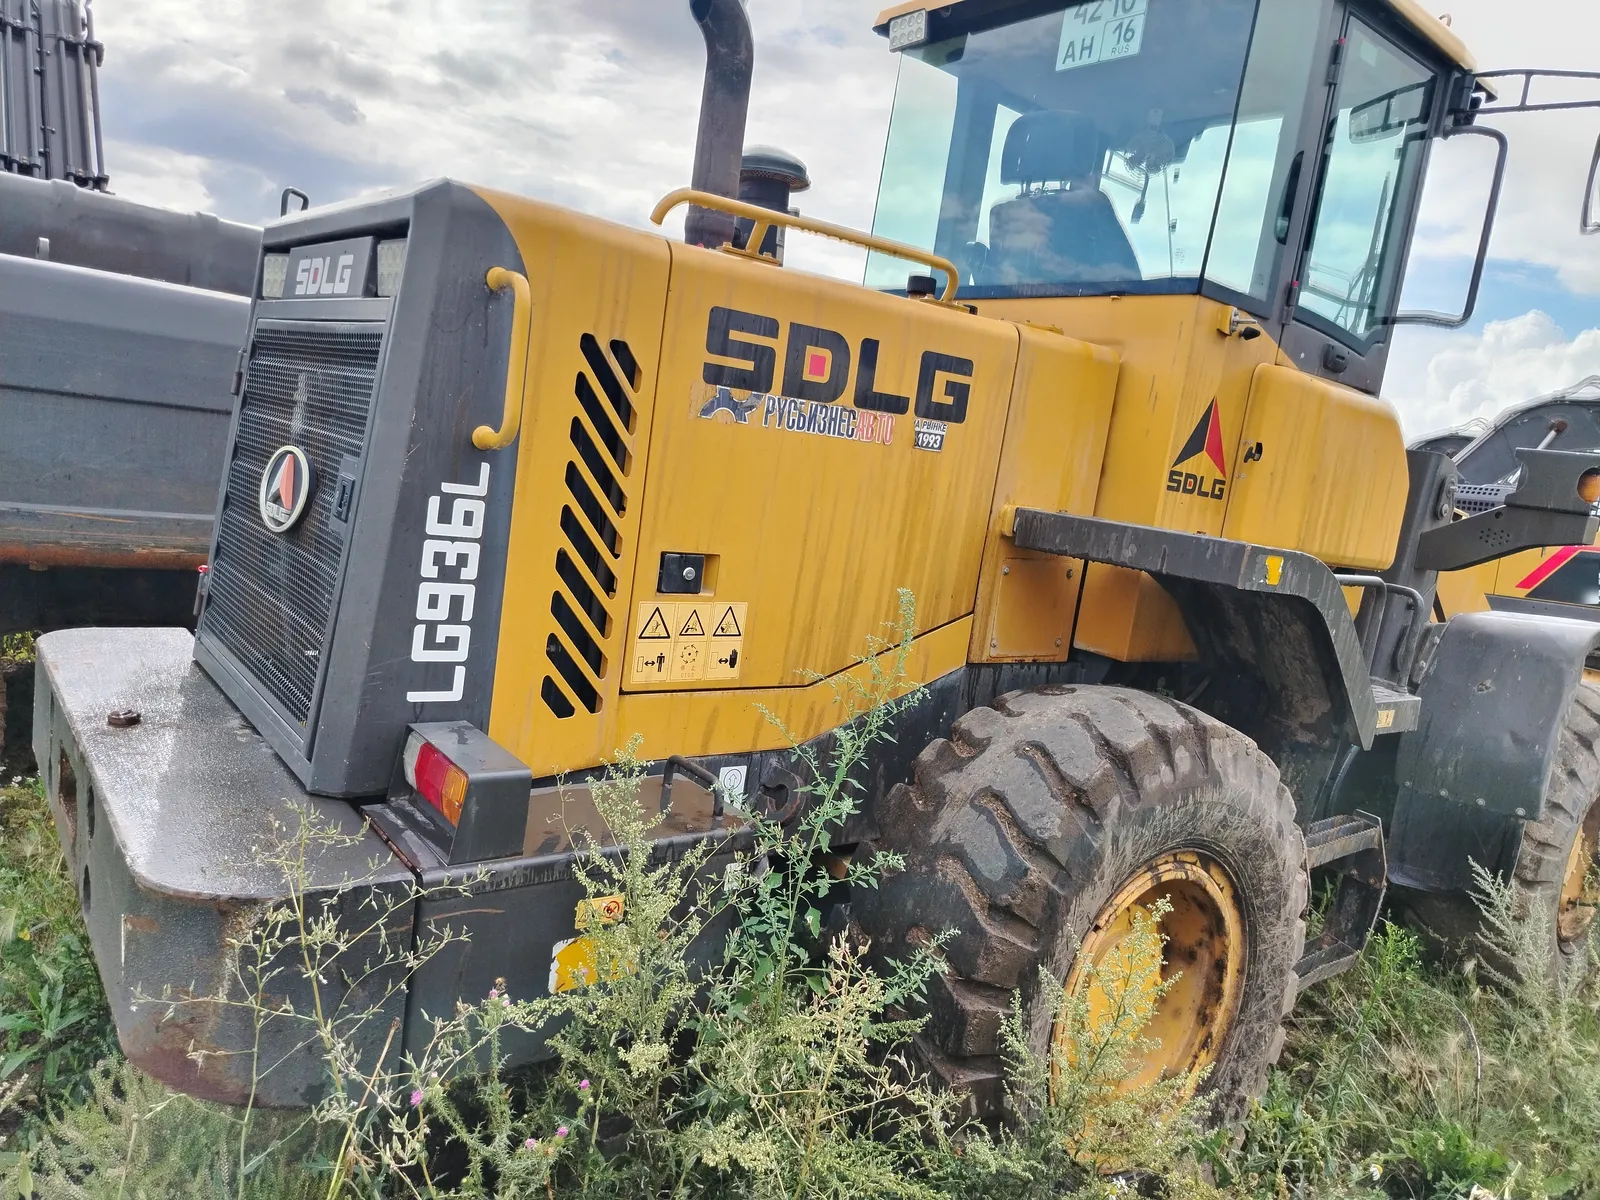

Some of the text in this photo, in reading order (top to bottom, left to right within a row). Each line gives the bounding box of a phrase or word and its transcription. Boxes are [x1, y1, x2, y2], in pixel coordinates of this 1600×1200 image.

[1112, 19, 1136, 45] 16
[1111, 44, 1130, 56] RUS
[294, 254, 354, 295] SDLG
[702, 305, 974, 424] SDLG
[917, 433, 941, 448] 1993
[1166, 469, 1226, 500] SDLG
[406, 462, 491, 702] LG936L
